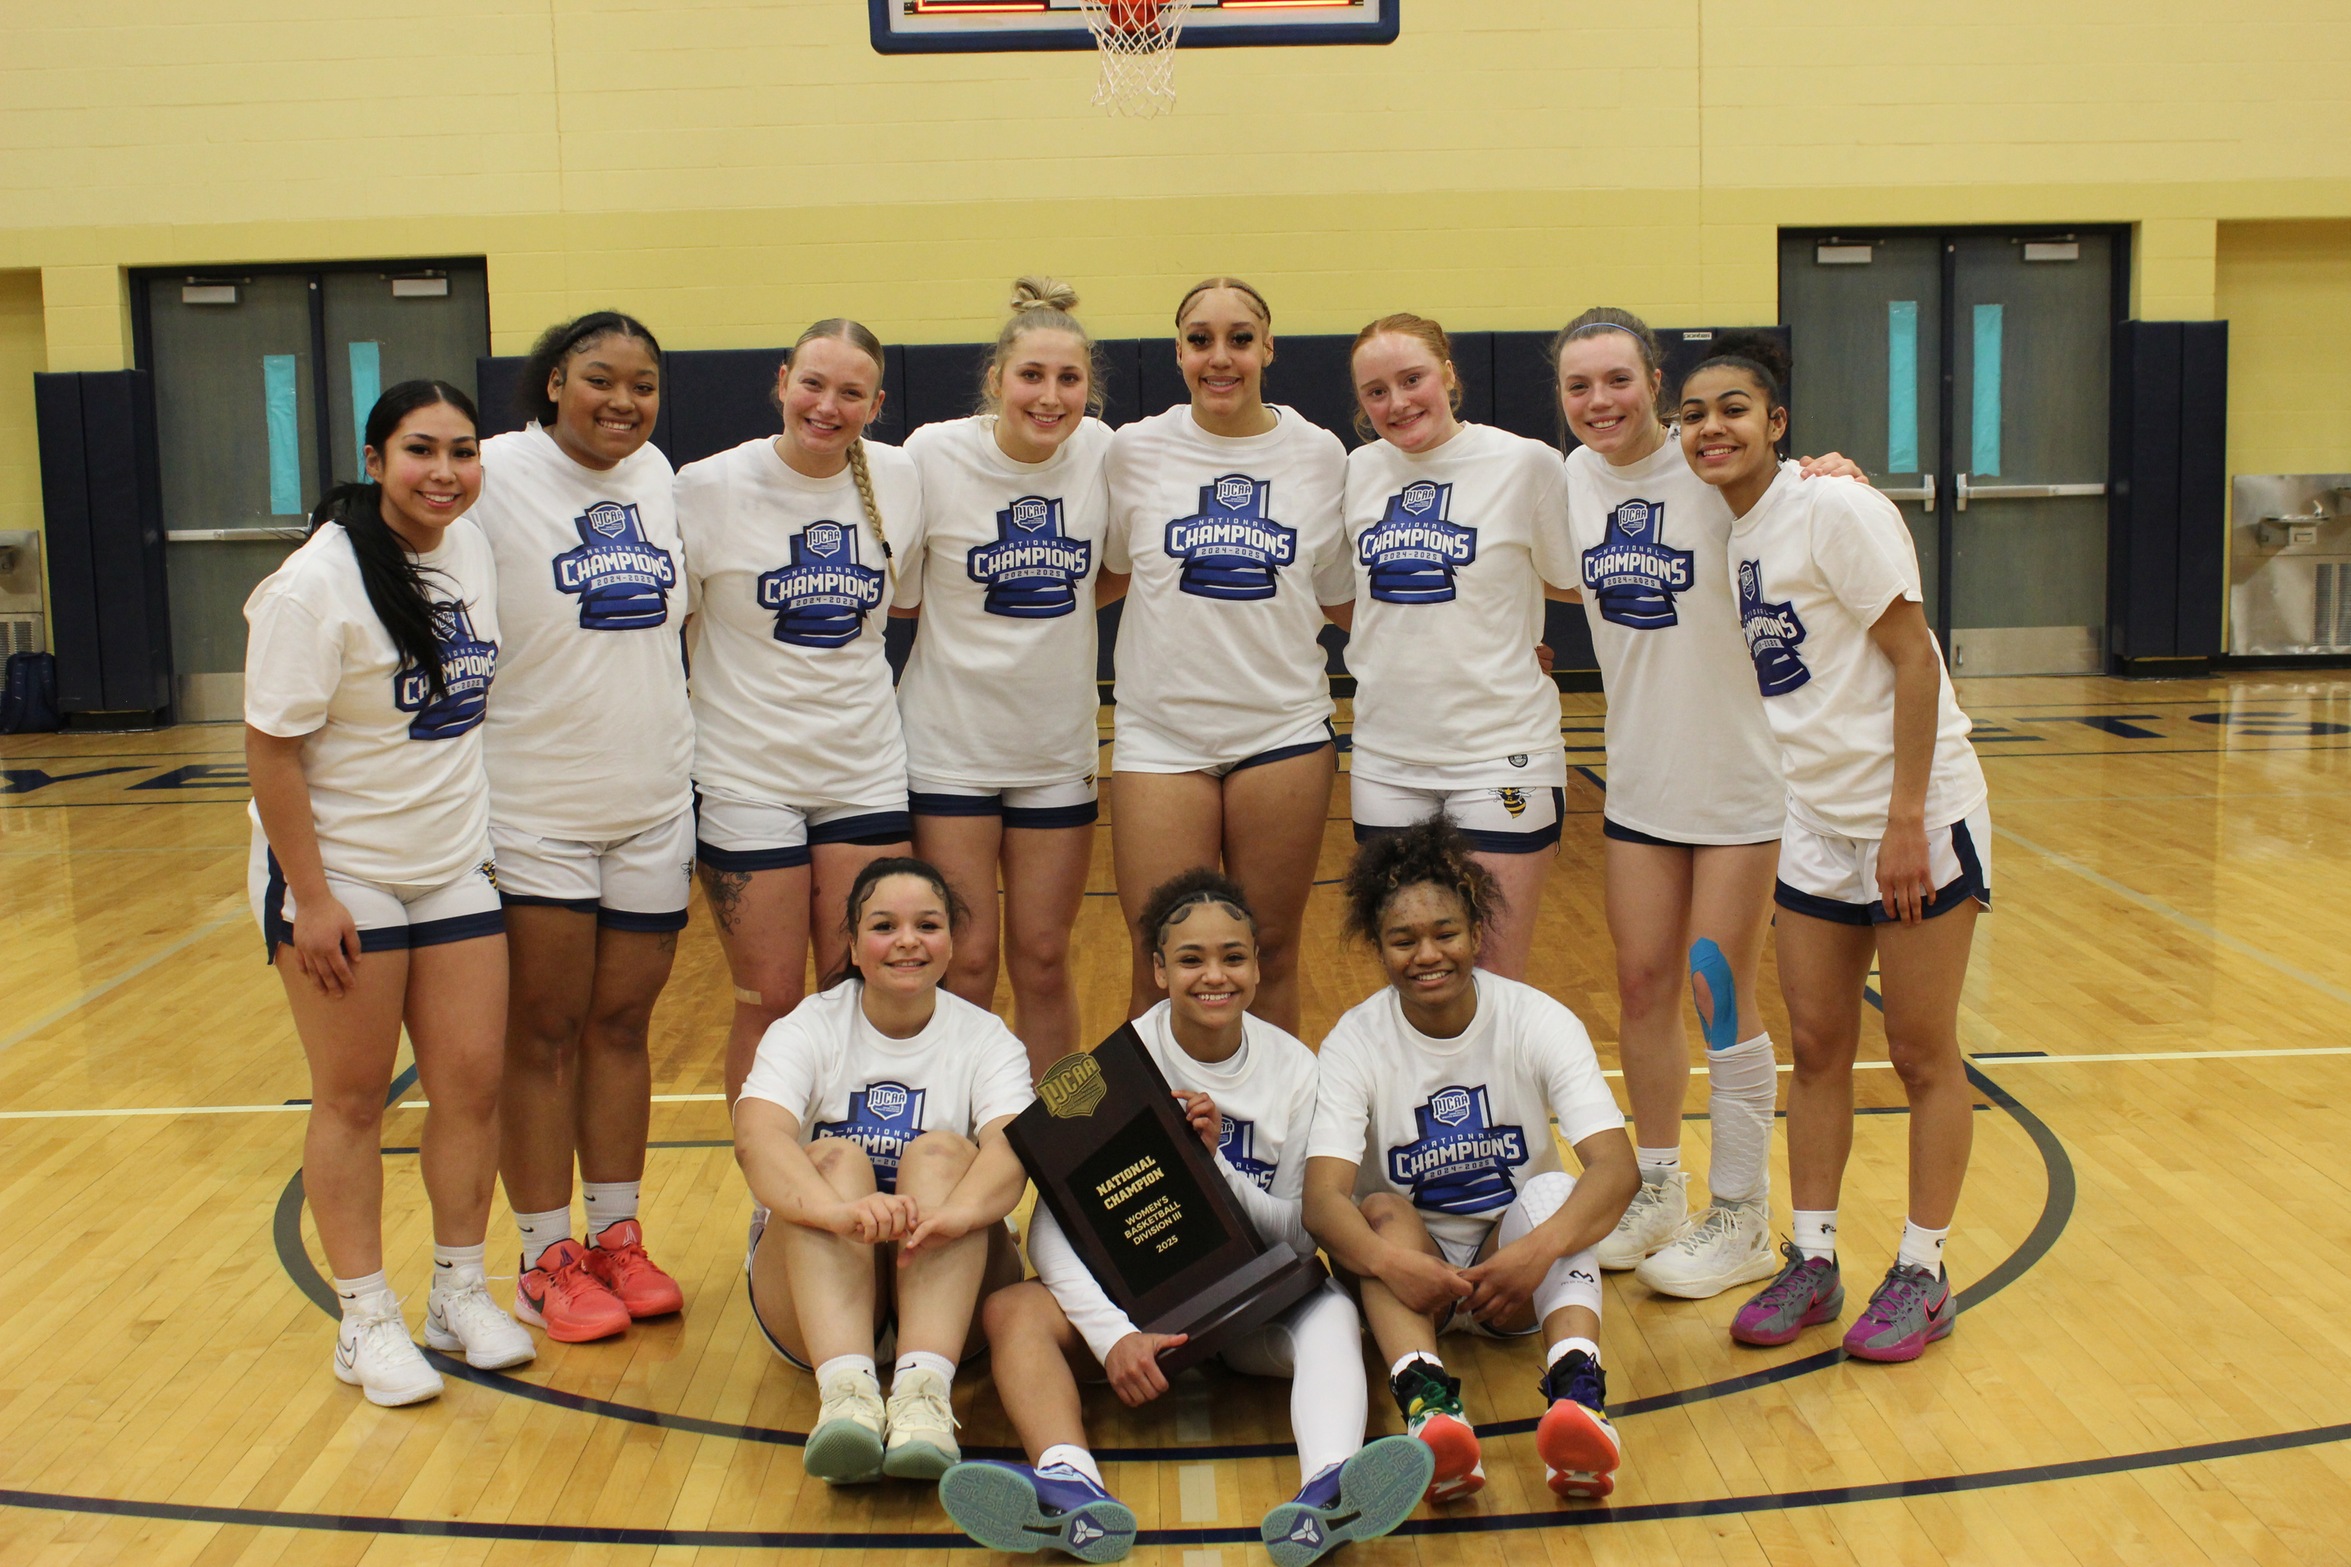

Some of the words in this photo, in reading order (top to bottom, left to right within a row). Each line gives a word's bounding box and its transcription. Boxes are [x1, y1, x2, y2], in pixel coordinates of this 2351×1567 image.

[1219, 484, 1251, 498] NJCAA
[1404, 489, 1434, 504] NJCAA
[591, 511, 623, 527] NJCAA
[1014, 505, 1046, 521] NJCAA
[1619, 509, 1647, 524] NJCAA
[1199, 517, 1266, 530] NATIONAL
[1382, 522, 1445, 532] NATIONAL
[808, 530, 840, 546] NJCAA
[1000, 540, 1064, 552] NATIONAL
[1171, 524, 1290, 559] CHAMPIONS
[1361, 529, 1469, 559] CHAMPIONS
[587, 545, 649, 556] NATIONAL
[1202, 547, 1260, 559] 2024-2025
[1384, 551, 1437, 561] 2024-2025
[1604, 545, 1659, 556] NATIONAL
[561, 552, 672, 586] CHAMPIONS
[974, 547, 1086, 577] CHAMPIONS
[1585, 553, 1686, 584] CHAMPIONS
[597, 574, 652, 585] 2024-2025
[792, 566, 859, 577] NATIONAL
[1004, 569, 1061, 579] 2024-2025
[764, 574, 880, 603] CHAMPIONS
[796, 597, 854, 606] 2024-2025
[441, 647, 480, 661] TIONAL
[403, 650, 496, 704] CHMPIONS
[1040, 1058, 1098, 1112] NJCAA
[870, 1090, 905, 1105] NJCAA
[1434, 1095, 1468, 1115] NJCAA
[1422, 1132, 1493, 1151] NATIONAL
[1396, 1133, 1520, 1178] CHAMPIONS
[1096, 1155, 1156, 1196] NATIONAL
[1430, 1160, 1490, 1177] 2024-2025
[1103, 1167, 1165, 1210] CHAMPION
[1125, 1195, 1169, 1226] WOMEN'S
[1124, 1201, 1181, 1239] BASKETBALL
[1132, 1217, 1173, 1246] DIVISION
[1172, 1211, 1182, 1222] III
[1156, 1234, 1179, 1253] 2025
